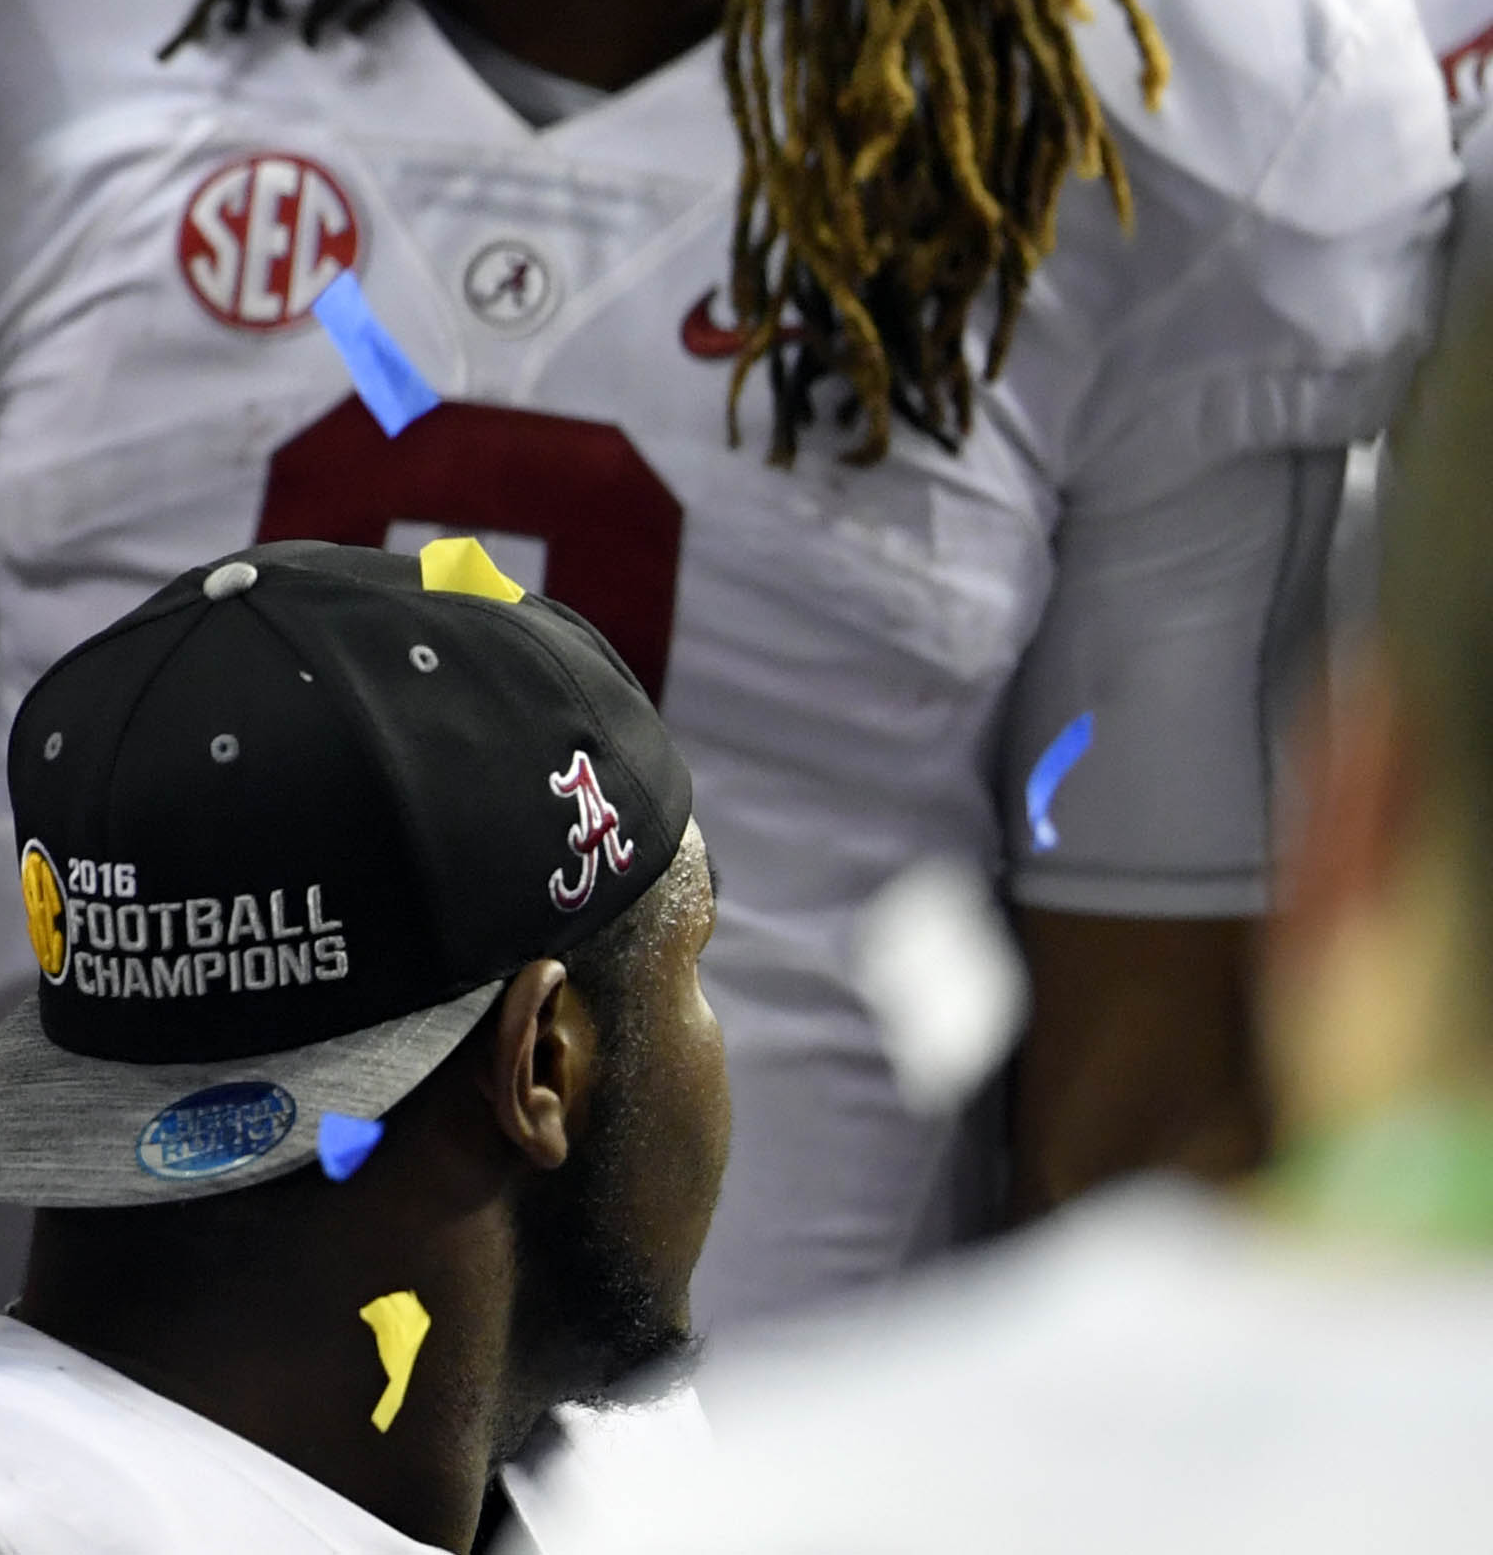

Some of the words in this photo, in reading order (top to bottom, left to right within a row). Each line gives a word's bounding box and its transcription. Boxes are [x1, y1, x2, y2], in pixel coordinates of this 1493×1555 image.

[189, 159, 347, 322] SEC
[68, 857, 137, 897] 2016
[69, 884, 343, 953] FOOTBALL
[74, 934, 349, 998] CHAMPIONS
